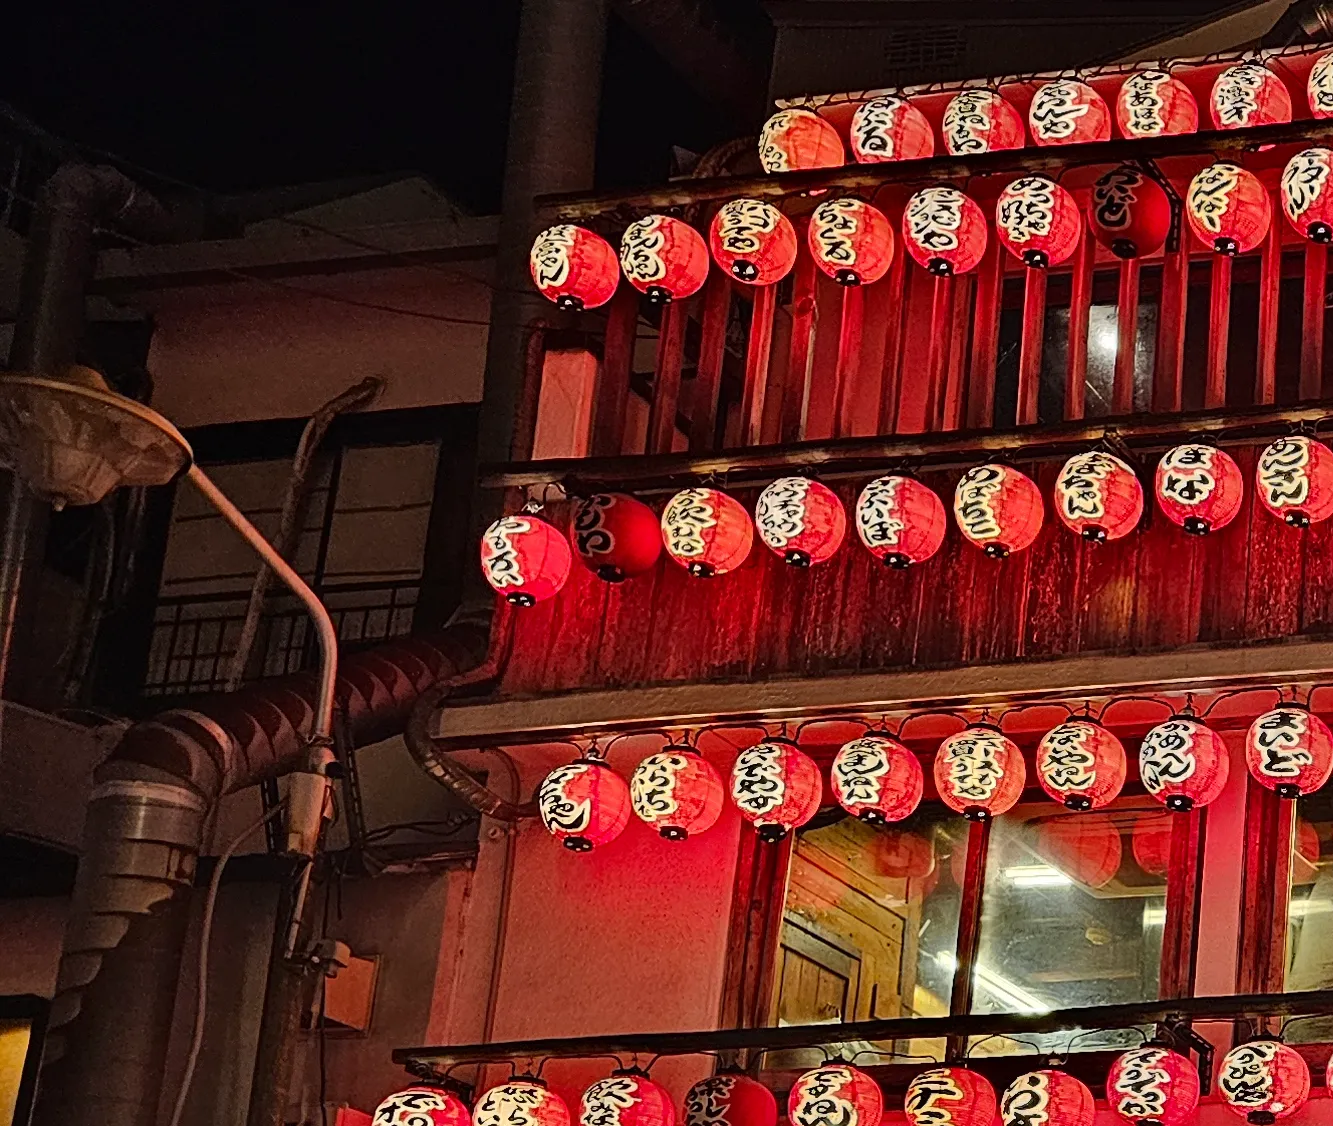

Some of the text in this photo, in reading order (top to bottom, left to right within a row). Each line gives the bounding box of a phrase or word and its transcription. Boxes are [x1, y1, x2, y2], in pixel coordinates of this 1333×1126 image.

[1165, 448, 1211, 505] ほな
[1256, 711, 1313, 775] まいど
